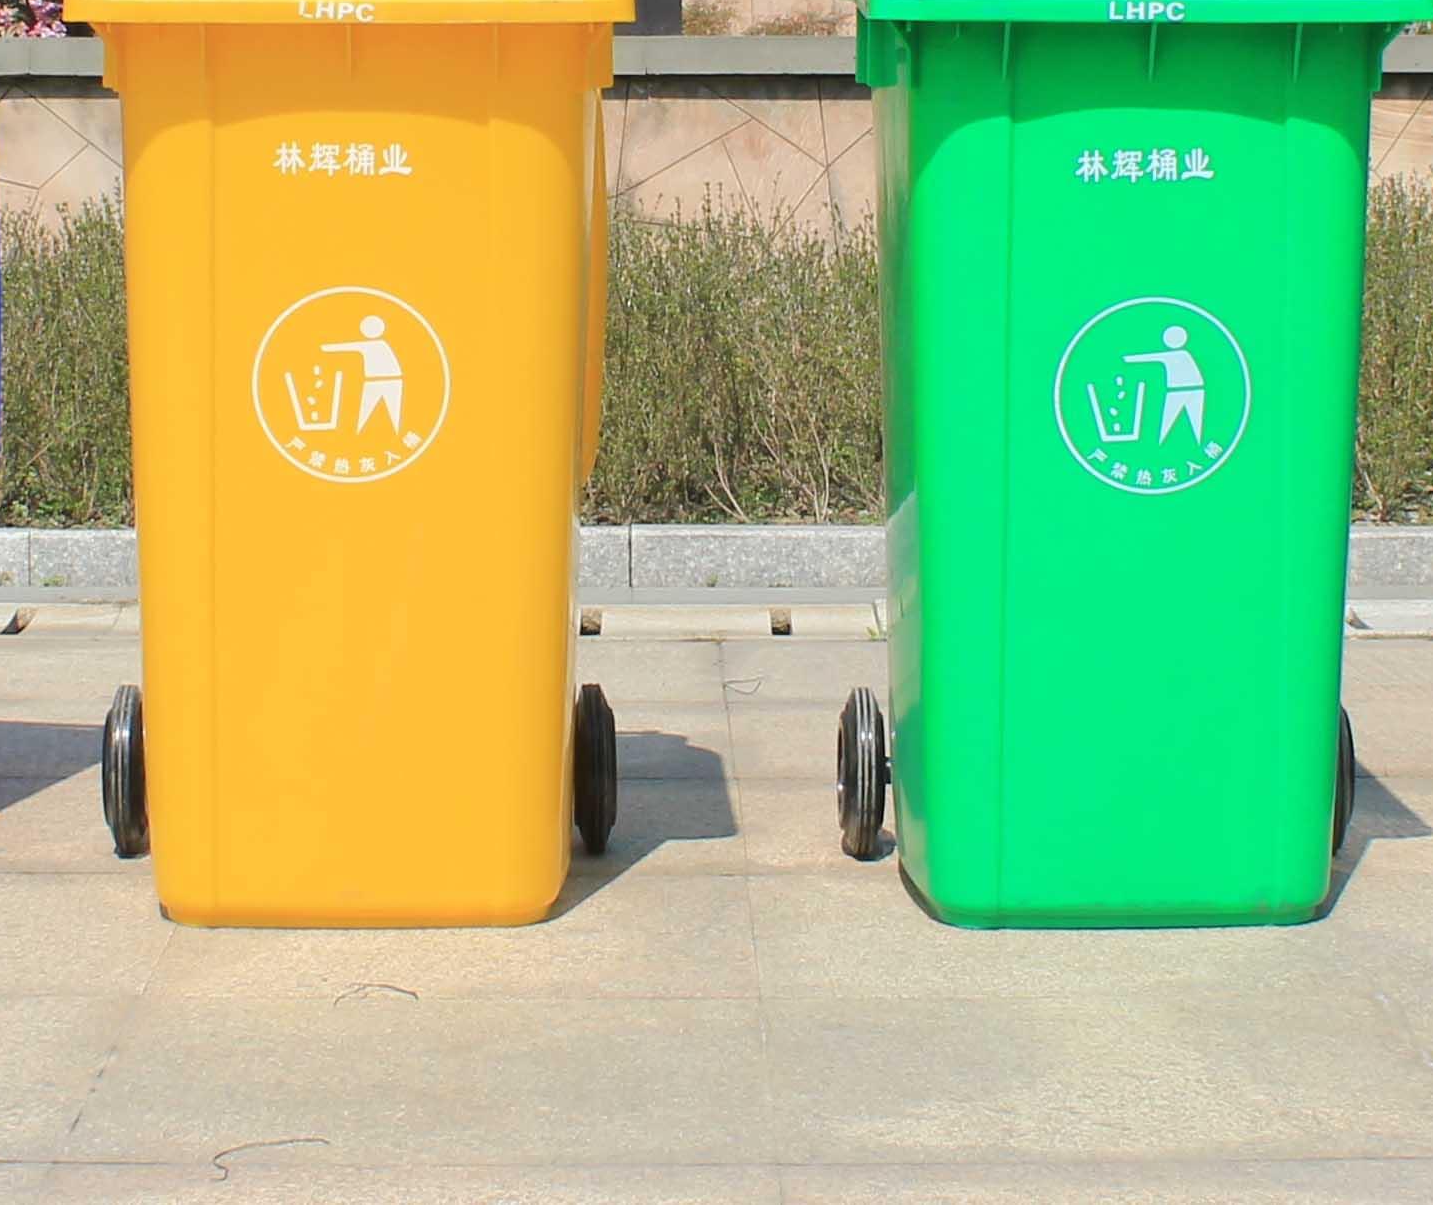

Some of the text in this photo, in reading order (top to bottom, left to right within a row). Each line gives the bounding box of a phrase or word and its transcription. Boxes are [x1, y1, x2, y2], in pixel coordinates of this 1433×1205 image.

[299, 0, 374, 22] LHPC
[1108, 0, 1185, 22] LHPC
[273, 143, 412, 176] 林辉桶业
[1075, 149, 1214, 182] 林辉桶业
[1086, 441, 1224, 487] 严禁热灰入桶
